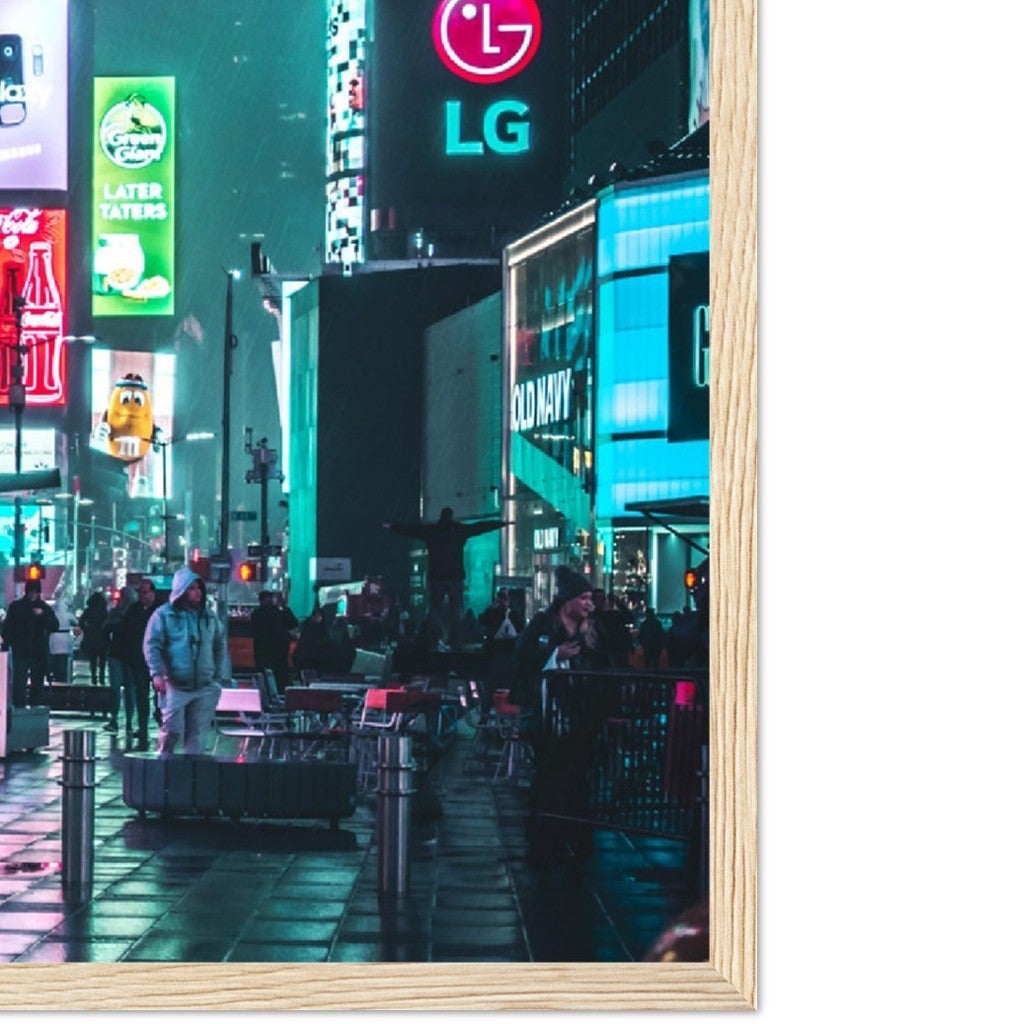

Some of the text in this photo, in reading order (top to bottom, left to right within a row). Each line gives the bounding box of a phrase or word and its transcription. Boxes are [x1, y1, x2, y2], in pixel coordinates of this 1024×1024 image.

[446, 100, 530, 156] LG
[104, 182, 162, 199] LATER
[99, 203, 167, 220] TATERS
[511, 368, 572, 432] OLD NAVY
